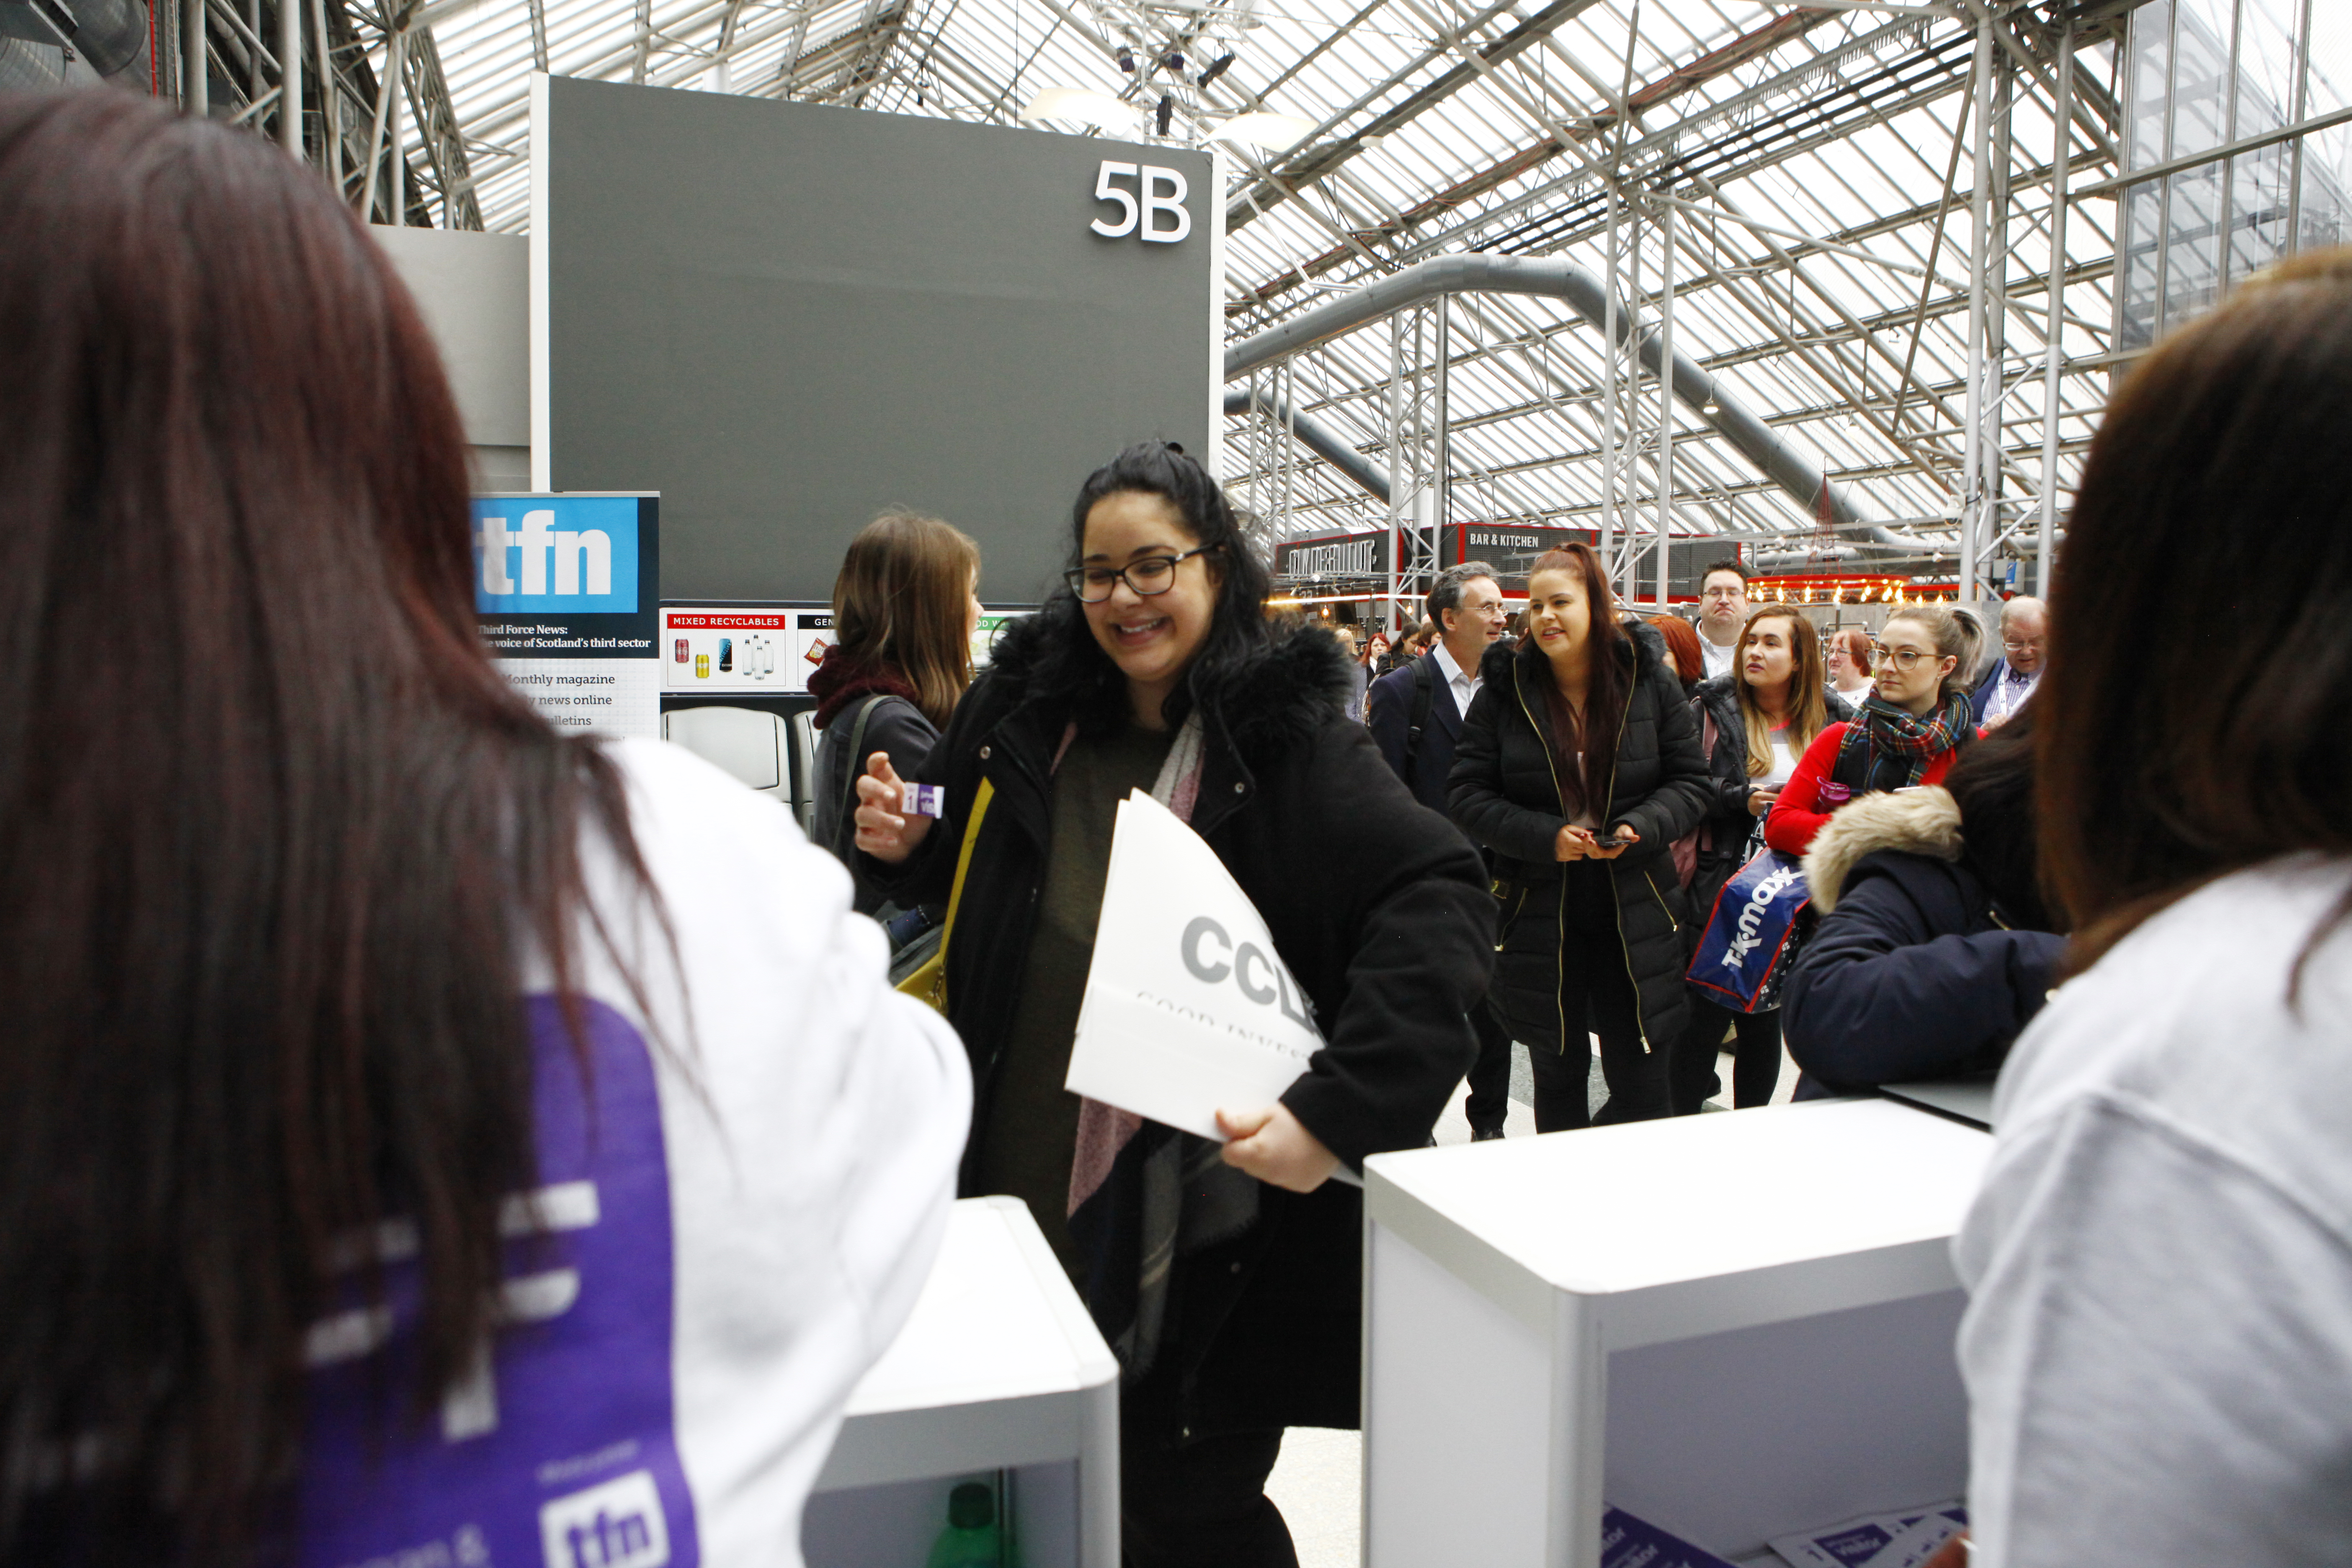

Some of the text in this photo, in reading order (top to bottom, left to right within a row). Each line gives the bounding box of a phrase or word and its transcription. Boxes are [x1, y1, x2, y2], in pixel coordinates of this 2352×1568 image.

[1090, 160, 1191, 242] 5B
[1470, 533, 1538, 547] BAR & KITCHEN
[476, 509, 611, 595] tfn
[478, 625, 568, 634] Third Force News:
[495, 638, 522, 647] voice
[524, 638, 536, 647] of
[536, 638, 589, 647] Scotland's
[591, 638, 616, 647] third
[618, 639, 651, 648] sector
[505, 675, 615, 687] Monthly magazine
[573, 695, 612, 705] online
[544, 716, 592, 726] ulletins
